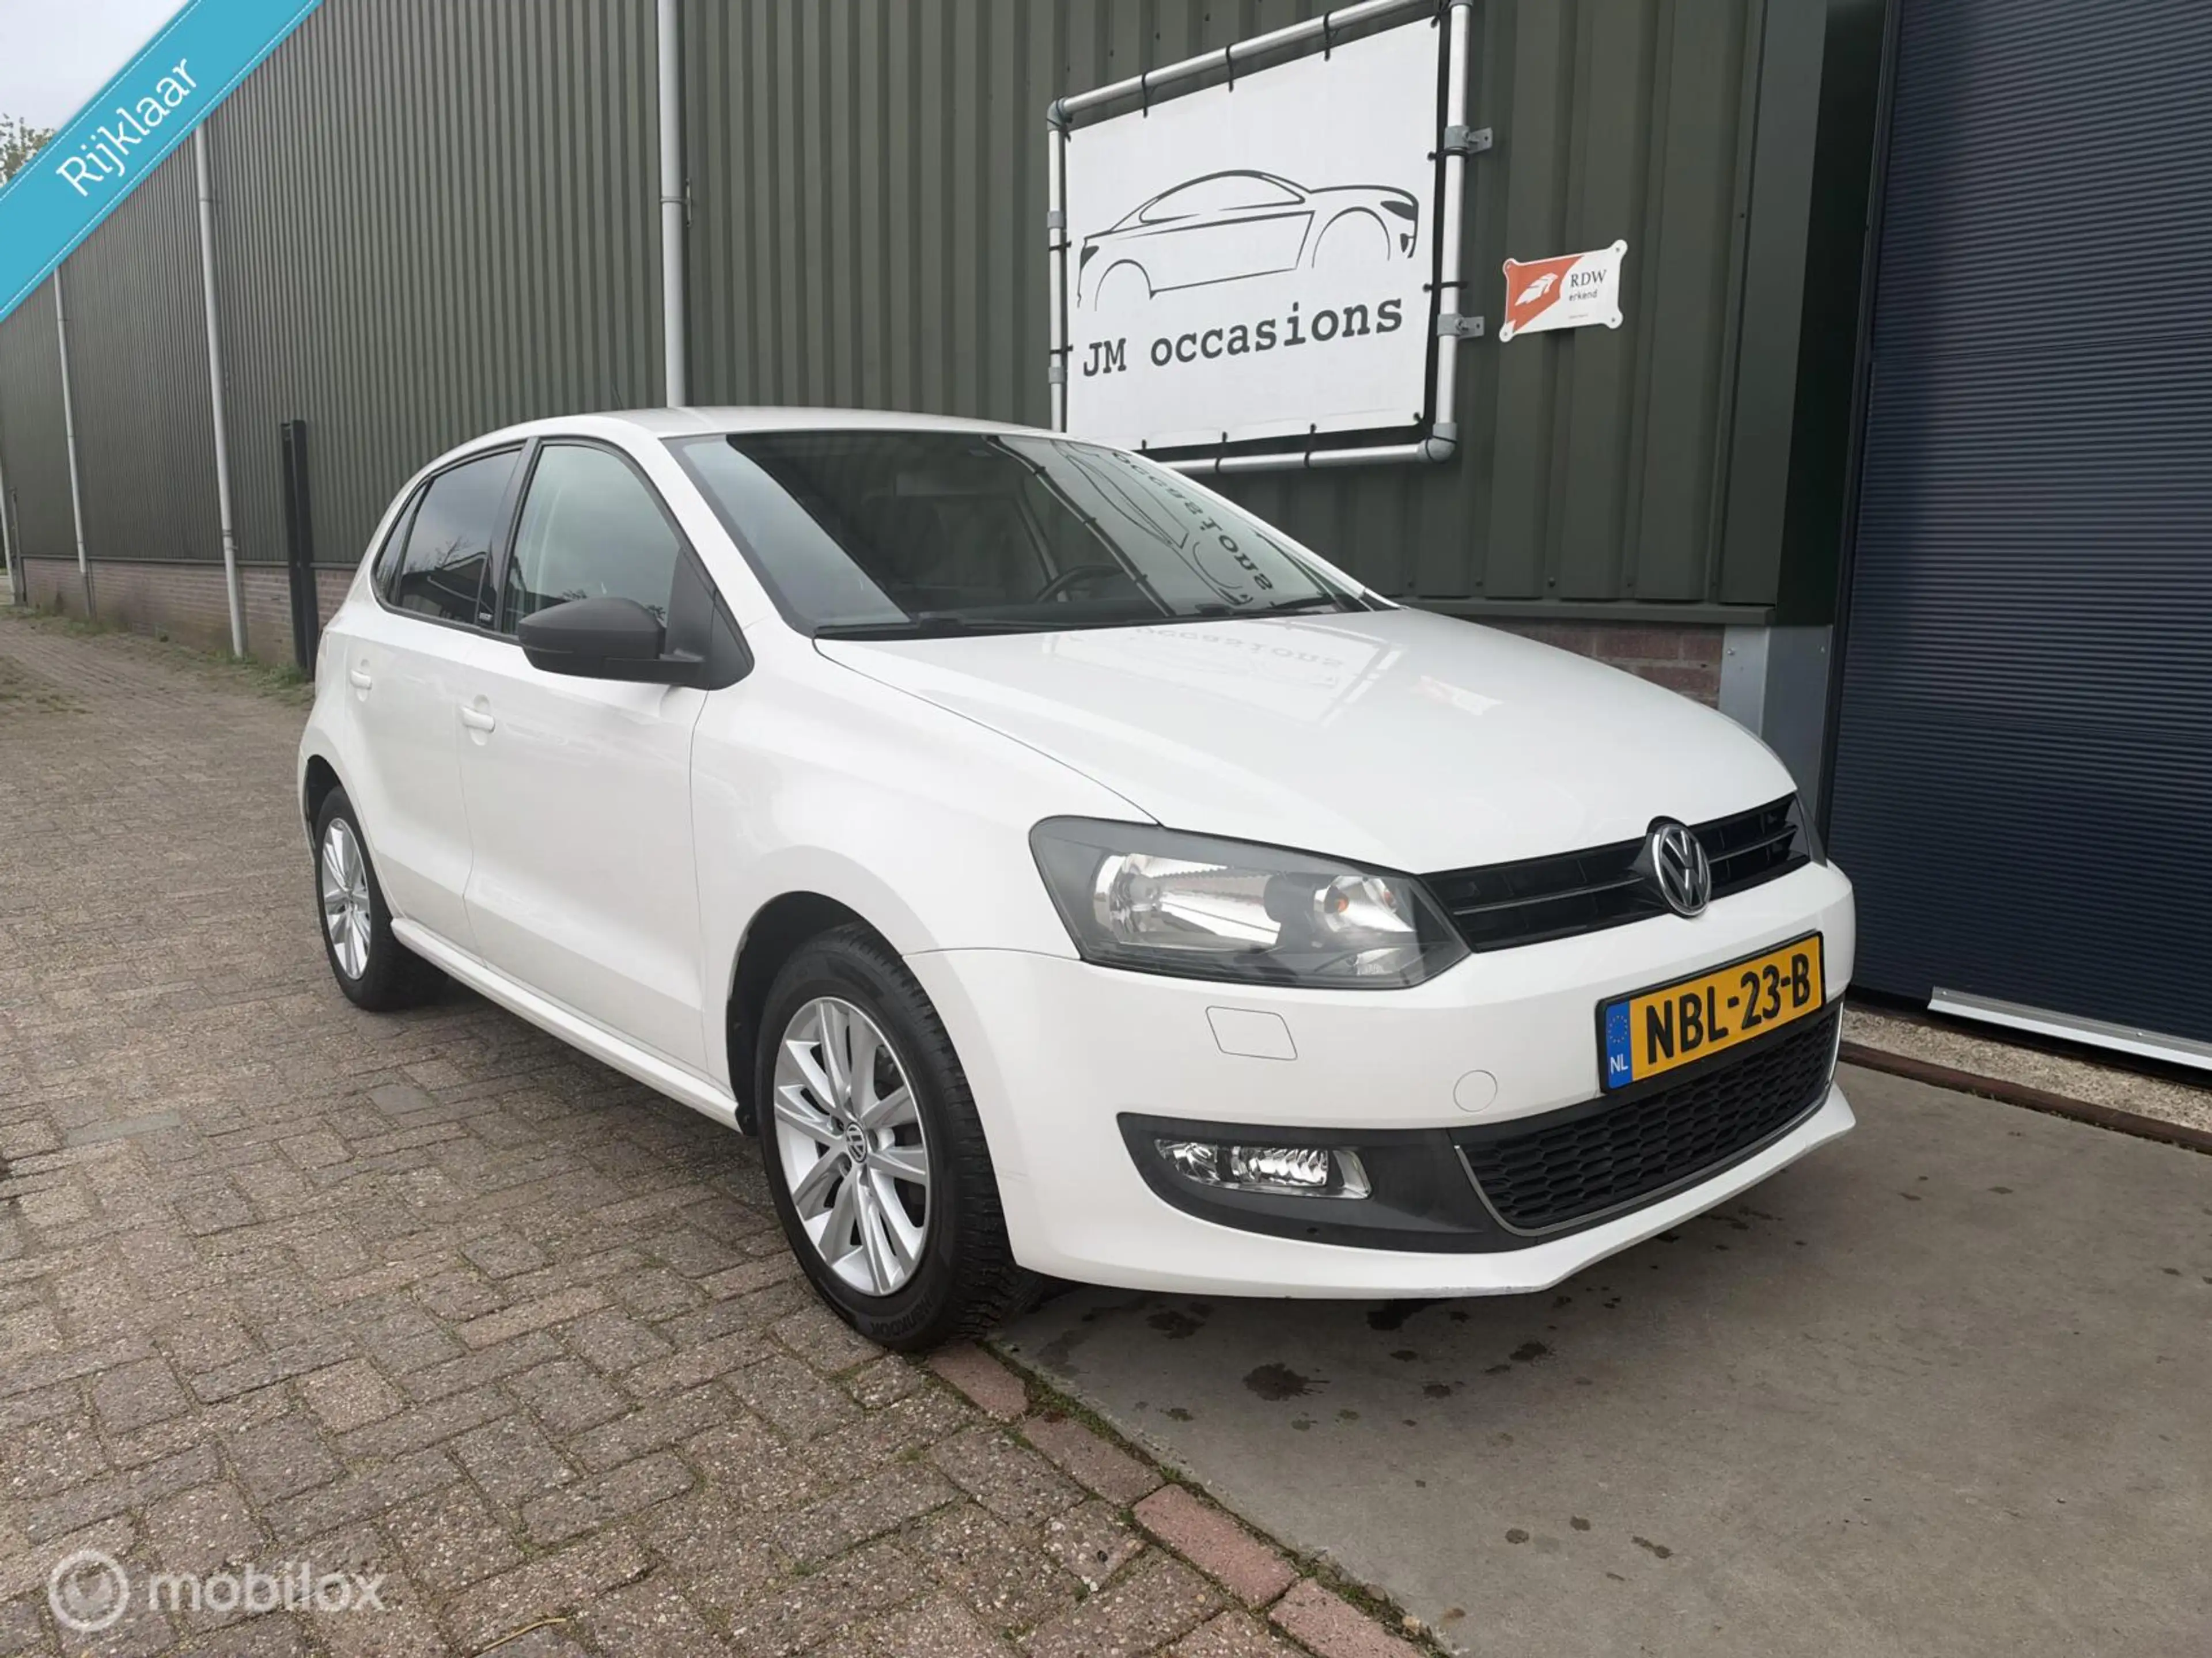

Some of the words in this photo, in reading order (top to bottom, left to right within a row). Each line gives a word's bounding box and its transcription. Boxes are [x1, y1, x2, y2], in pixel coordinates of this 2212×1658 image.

[1571, 269, 1607, 287] RDW
[1569, 289, 1598, 301] erkend
[1083, 338, 1127, 377] JM
[1151, 298, 1402, 366] occasions
[1646, 953, 1810, 1065] NBL-23-B
[1610, 1053, 1628, 1075] NL
